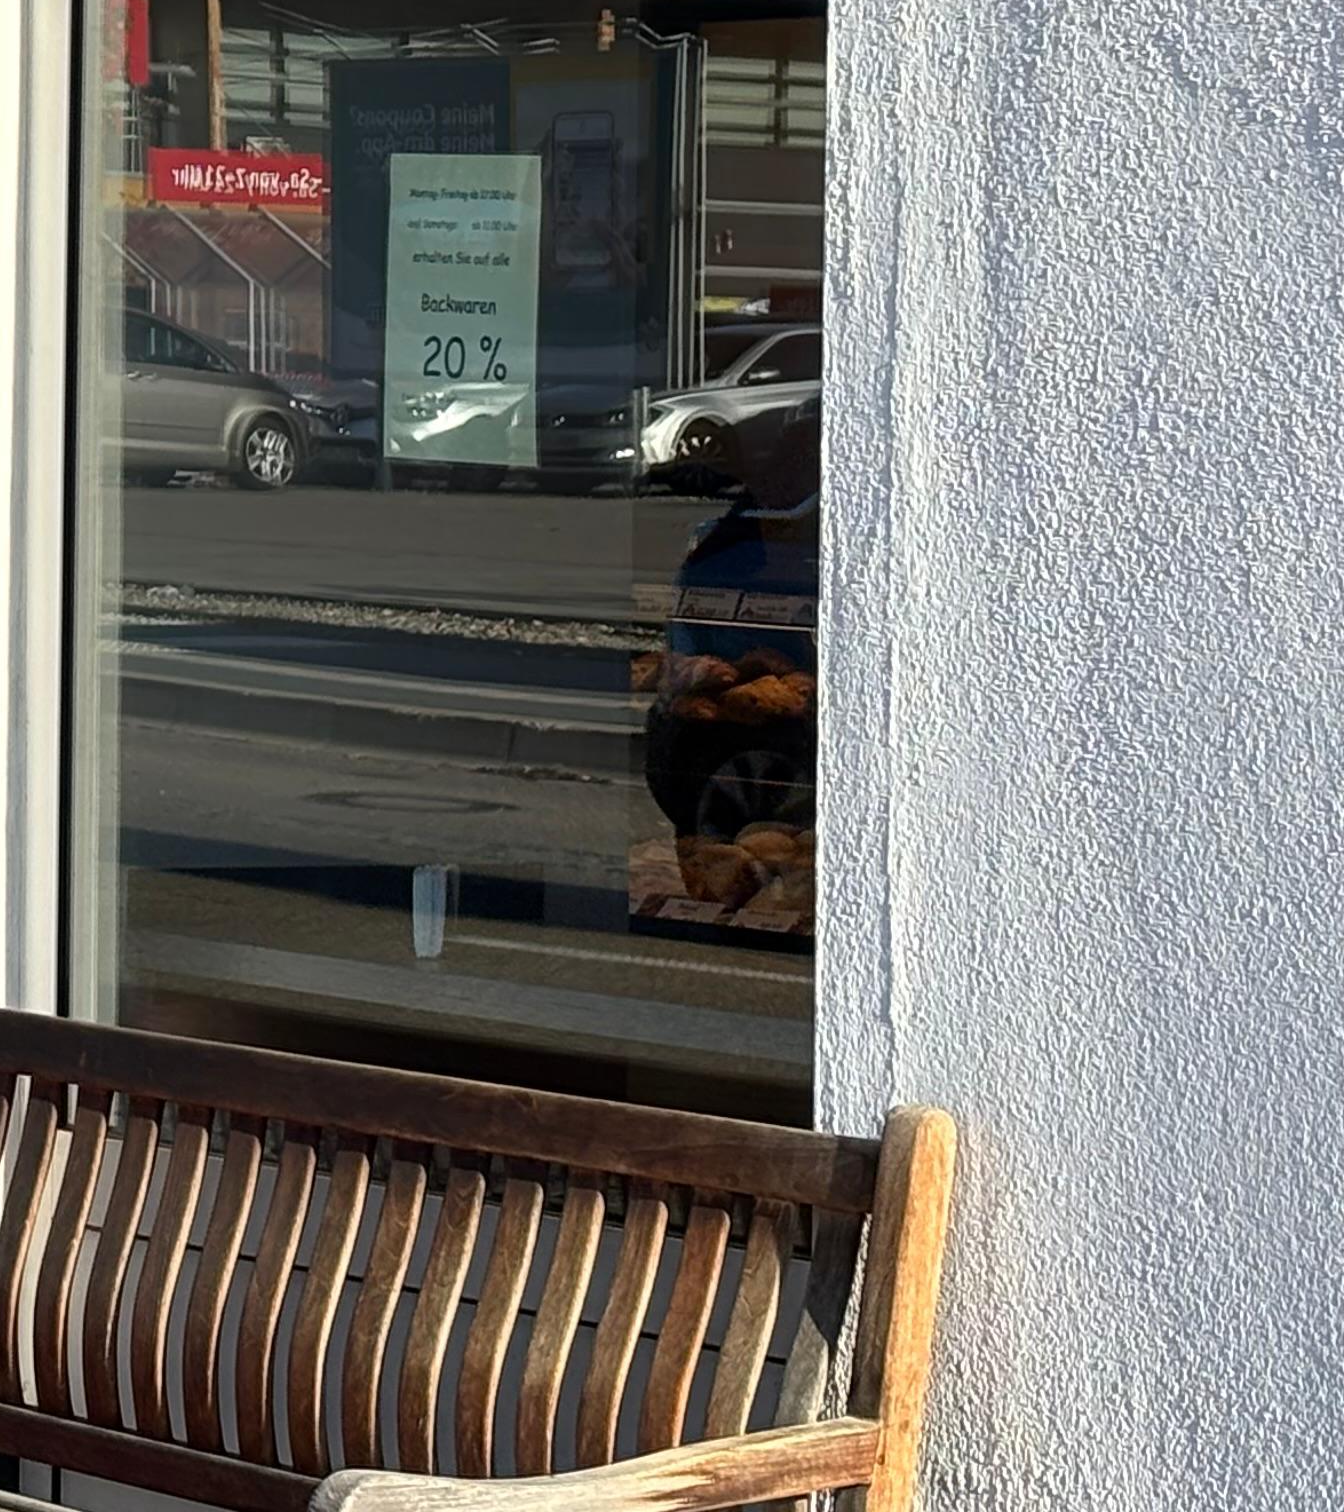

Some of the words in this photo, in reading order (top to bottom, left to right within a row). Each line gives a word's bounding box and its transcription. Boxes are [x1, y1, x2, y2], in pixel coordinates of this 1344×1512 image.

[413, 251, 453, 264] erhalten
[455, 251, 471, 264] Sie
[473, 252, 490, 266] auf
[492, 252, 510, 266] alle
[421, 292, 497, 316] Backwaren
[423, 335, 466, 379] 20
[479, 335, 508, 381] %
